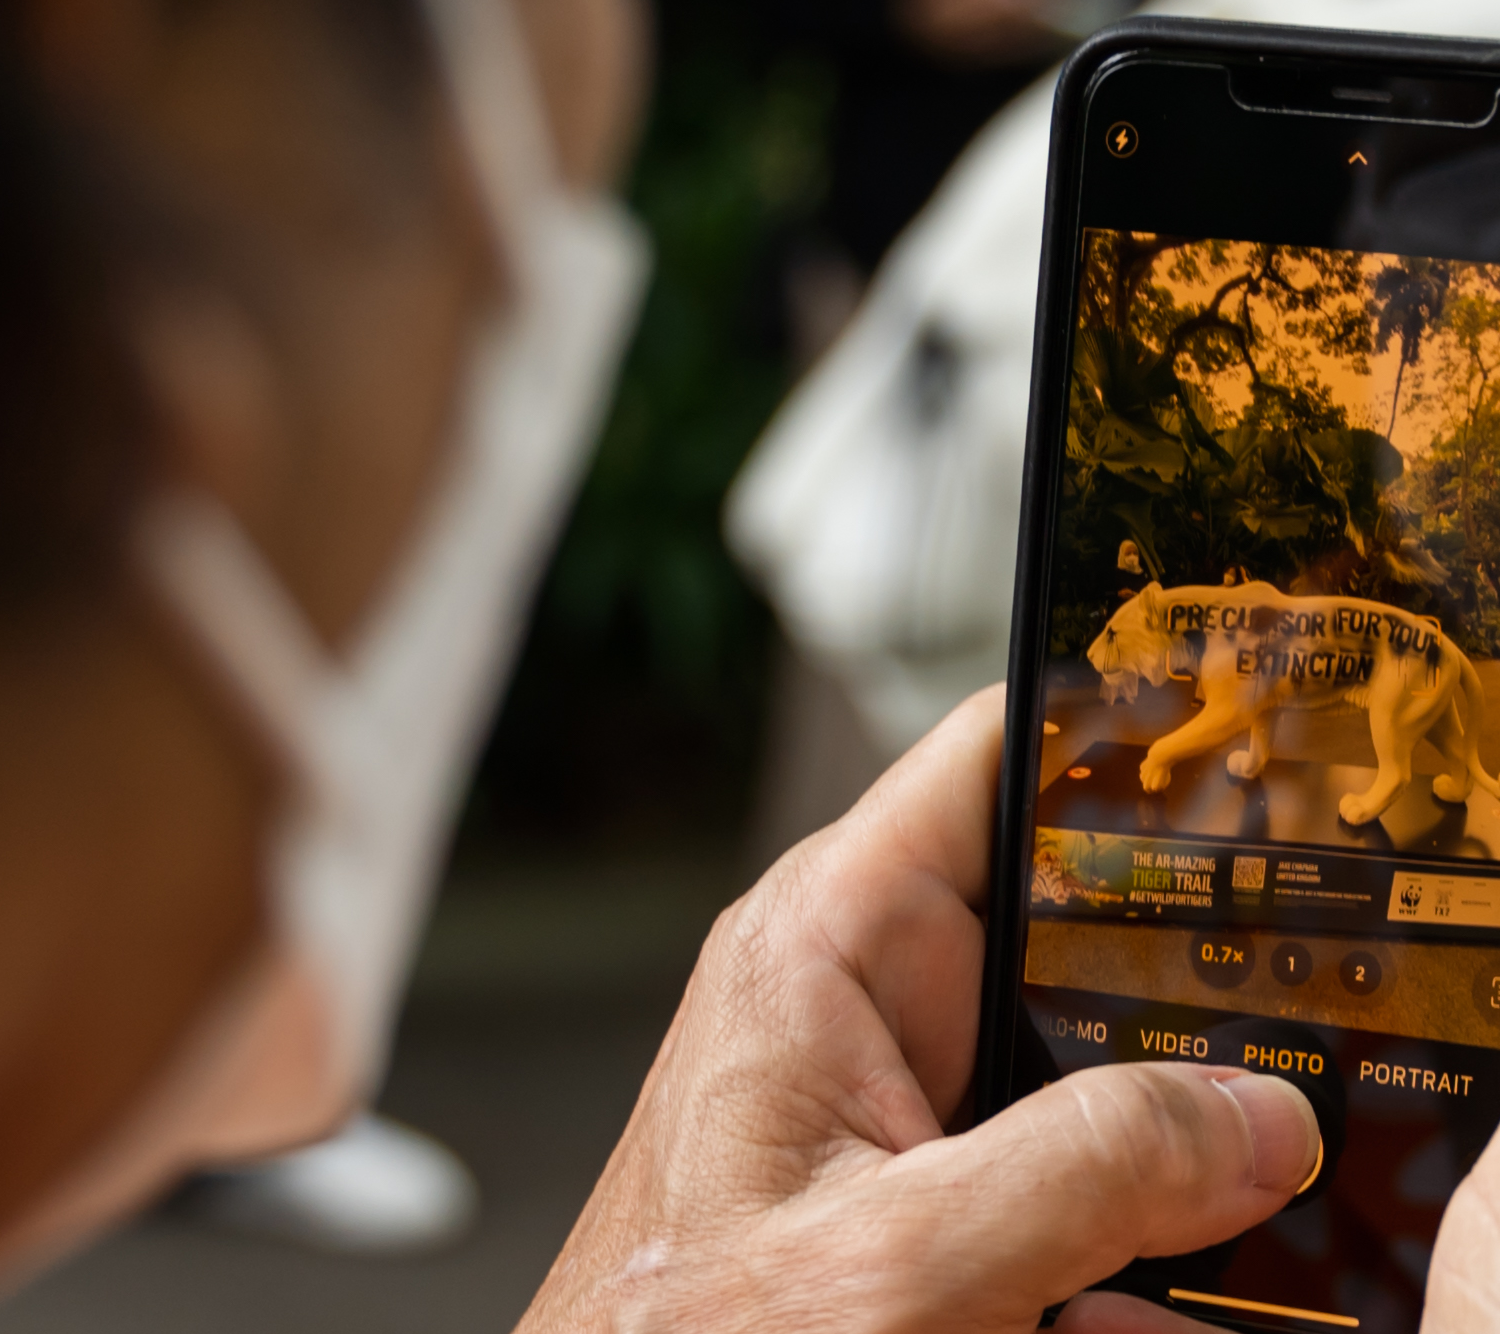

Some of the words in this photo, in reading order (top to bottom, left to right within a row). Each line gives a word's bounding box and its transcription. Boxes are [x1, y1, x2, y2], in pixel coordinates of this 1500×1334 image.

[1169, 604, 1326, 639] PRECUSOR
[1335, 608, 1381, 639] FOR
[1237, 649, 1374, 681] EXTINCTION
[1132, 851, 1153, 867] THE
[1155, 854, 1216, 873] AR-MAZING
[1132, 869, 1171, 890] TIGER
[1175, 872, 1214, 894] TRAIL
[1129, 890, 1213, 908] #GETWILDFORTIGERS
[1288, 956, 1295, 972] 1
[1355, 965, 1365, 982] 2
[1140, 1028, 1209, 1059] VIDEO
[1243, 1044, 1324, 1075] PHOTO
[1360, 1060, 1474, 1097] PORTRAIT
